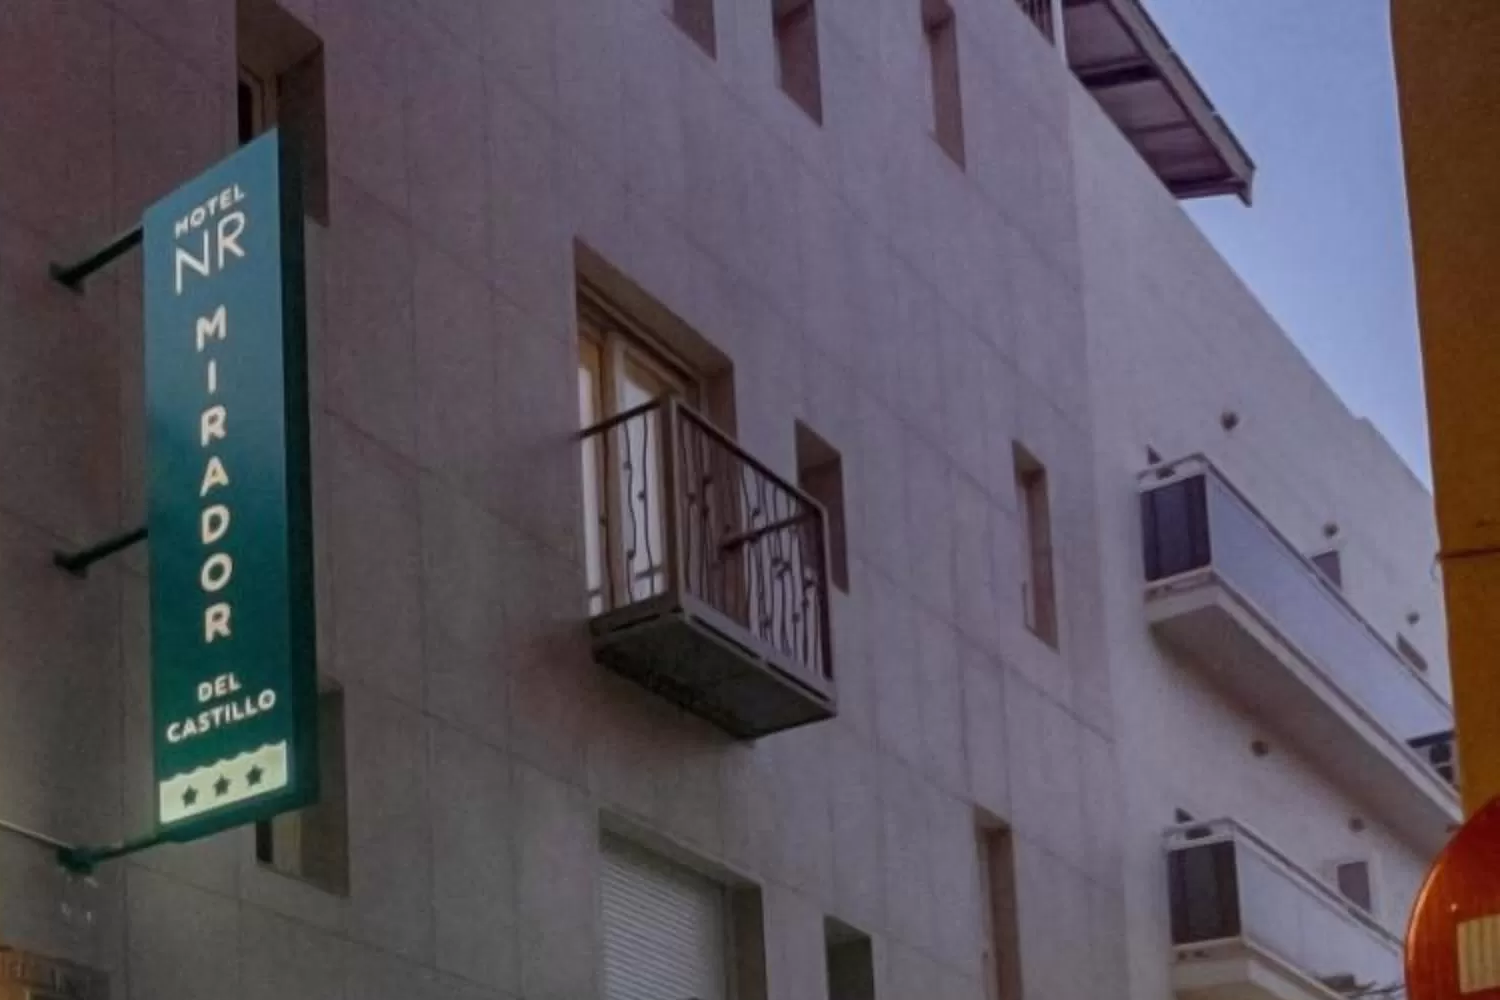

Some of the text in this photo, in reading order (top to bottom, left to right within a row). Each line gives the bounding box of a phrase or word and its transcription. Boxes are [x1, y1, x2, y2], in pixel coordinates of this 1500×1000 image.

[174, 183, 246, 240] HOTEL
[174, 210, 246, 295] NR
[195, 305, 233, 643] MIRADOR
[166, 689, 276, 743] CASTILLO
[197, 673, 241, 702] DEL
